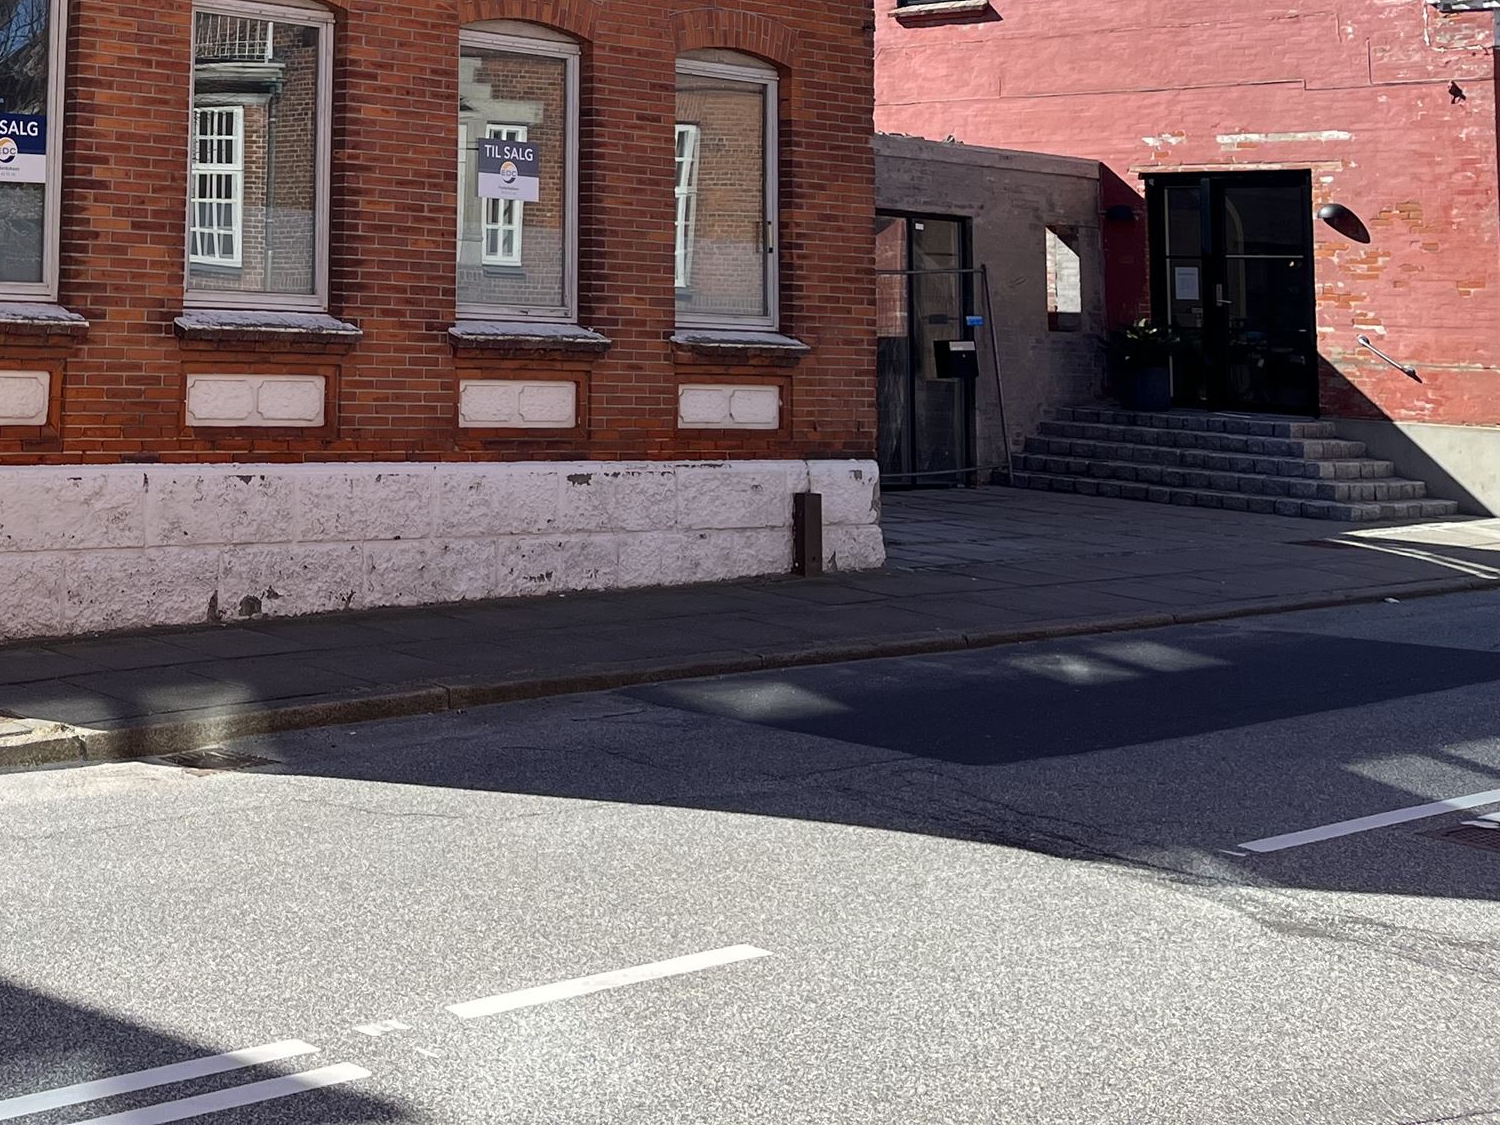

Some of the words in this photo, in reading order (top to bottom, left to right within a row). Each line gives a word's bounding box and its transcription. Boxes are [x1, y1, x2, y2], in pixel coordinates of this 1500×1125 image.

[0, 119, 39, 137] SALG
[484, 144, 502, 159] TIL
[503, 146, 534, 162] SALG
[501, 169, 517, 177] EDC
